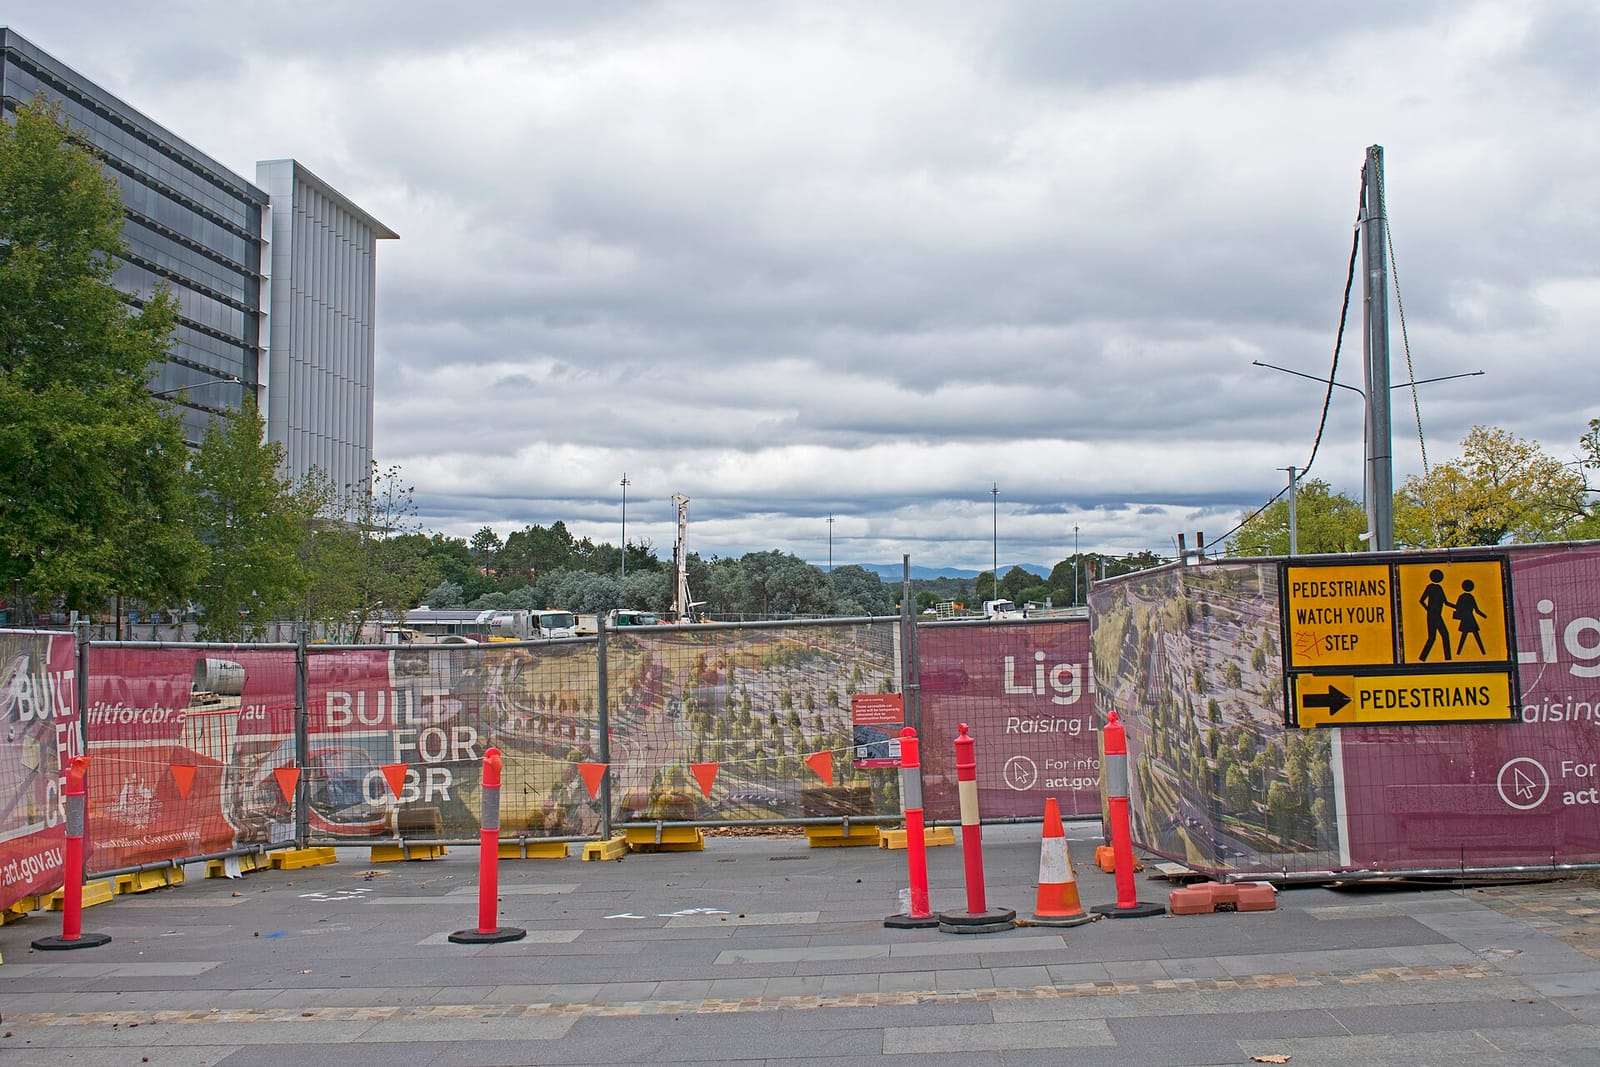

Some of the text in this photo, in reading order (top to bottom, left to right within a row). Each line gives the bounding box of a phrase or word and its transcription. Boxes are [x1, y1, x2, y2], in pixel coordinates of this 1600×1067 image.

[1293, 580, 1386, 598] PEDESTRIANS
[1296, 606, 1385, 625] WATCH YOUR
[1325, 634, 1359, 651] STEP
[1517, 599, 1600, 678] ig
[17, 670, 75, 722] BUILT
[326, 688, 450, 726] BUILT
[1360, 686, 1490, 709] PEDESTRIANS
[1006, 715, 1082, 736] Raising
[392, 726, 478, 764] FOR
[1045, 759, 1069, 771] For
[1561, 760, 1597, 778] For
[362, 767, 453, 807] CBR
